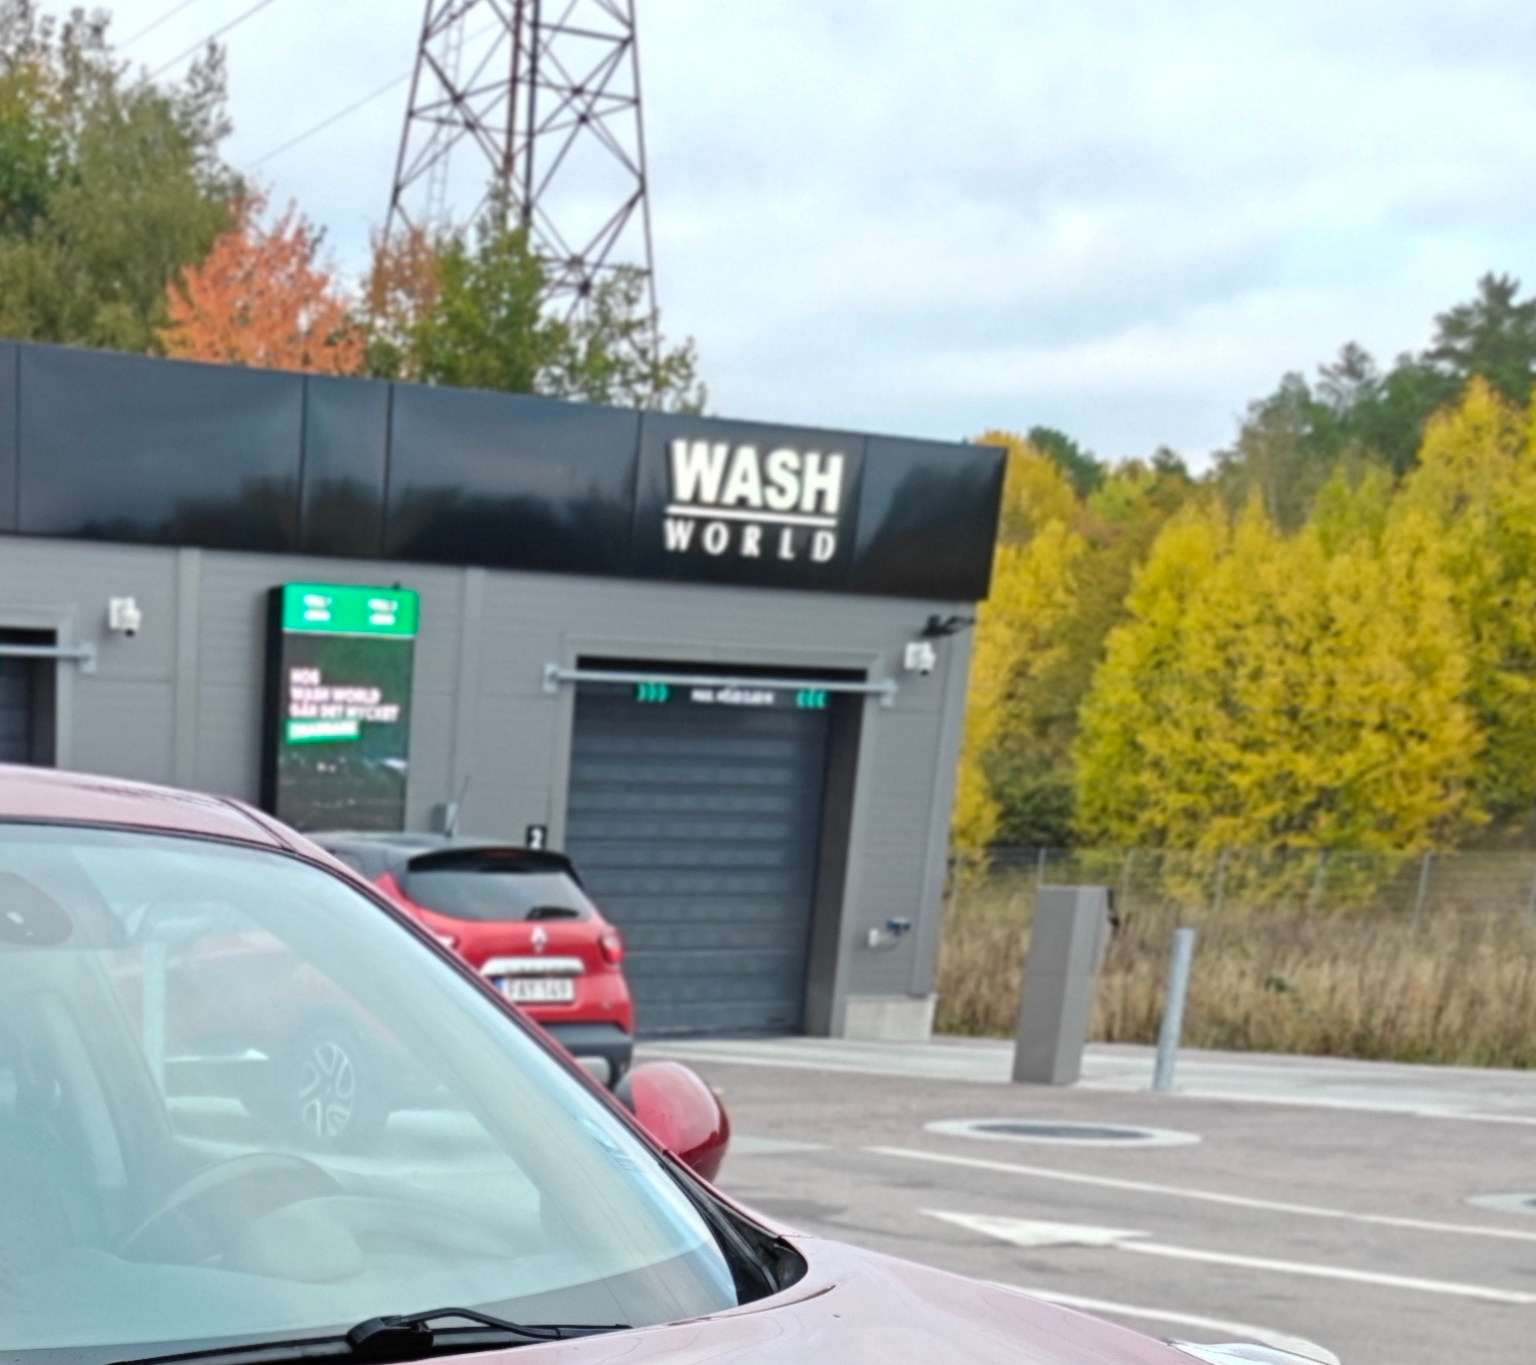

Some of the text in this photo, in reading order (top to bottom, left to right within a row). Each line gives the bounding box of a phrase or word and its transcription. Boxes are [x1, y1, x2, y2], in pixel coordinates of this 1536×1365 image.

[671, 439, 844, 514] WASH
[664, 518, 837, 562] WORLD
[529, 828, 543, 850] 2
